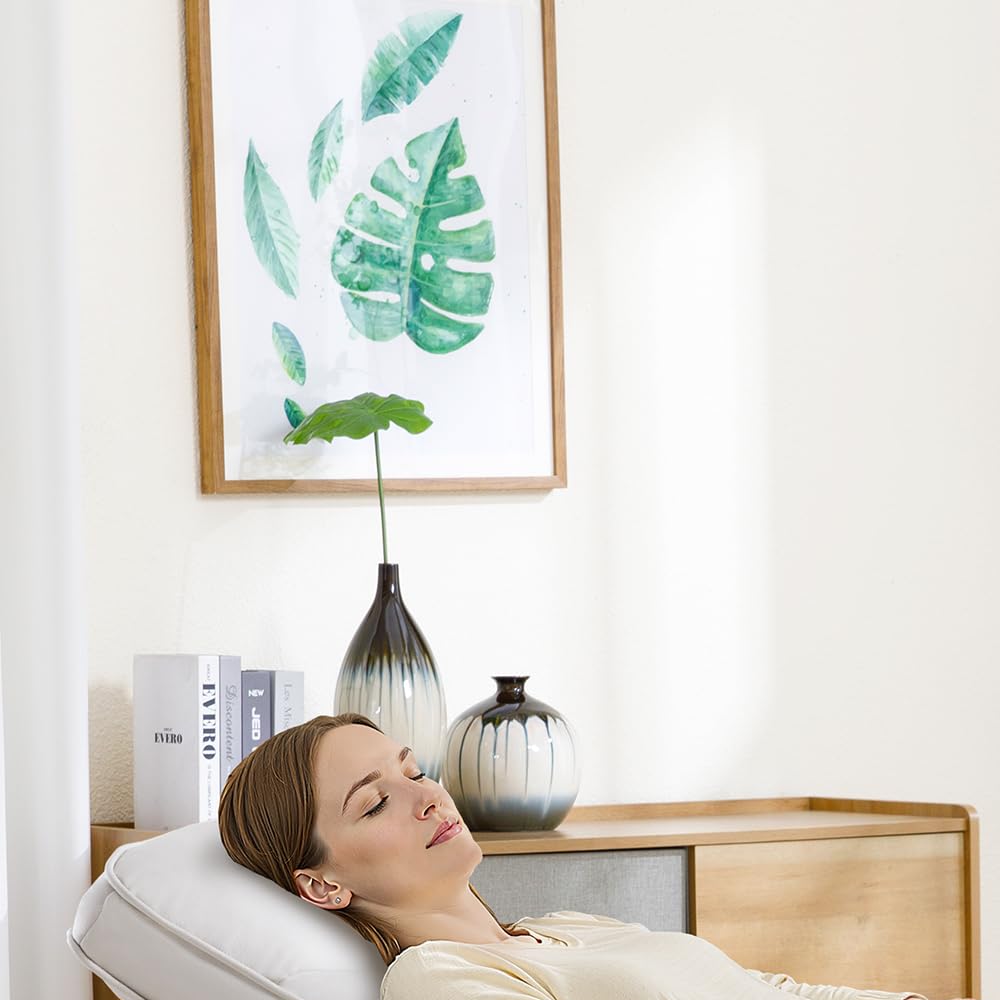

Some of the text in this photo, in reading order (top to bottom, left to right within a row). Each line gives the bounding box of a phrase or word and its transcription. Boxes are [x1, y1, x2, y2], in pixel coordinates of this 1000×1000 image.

[248, 689, 264, 697] NEW
[154, 732, 183, 744] EVERO
[203, 684, 216, 760] EVERO
[225, 684, 237, 762] Discontent
[251, 707, 261, 740] JED
